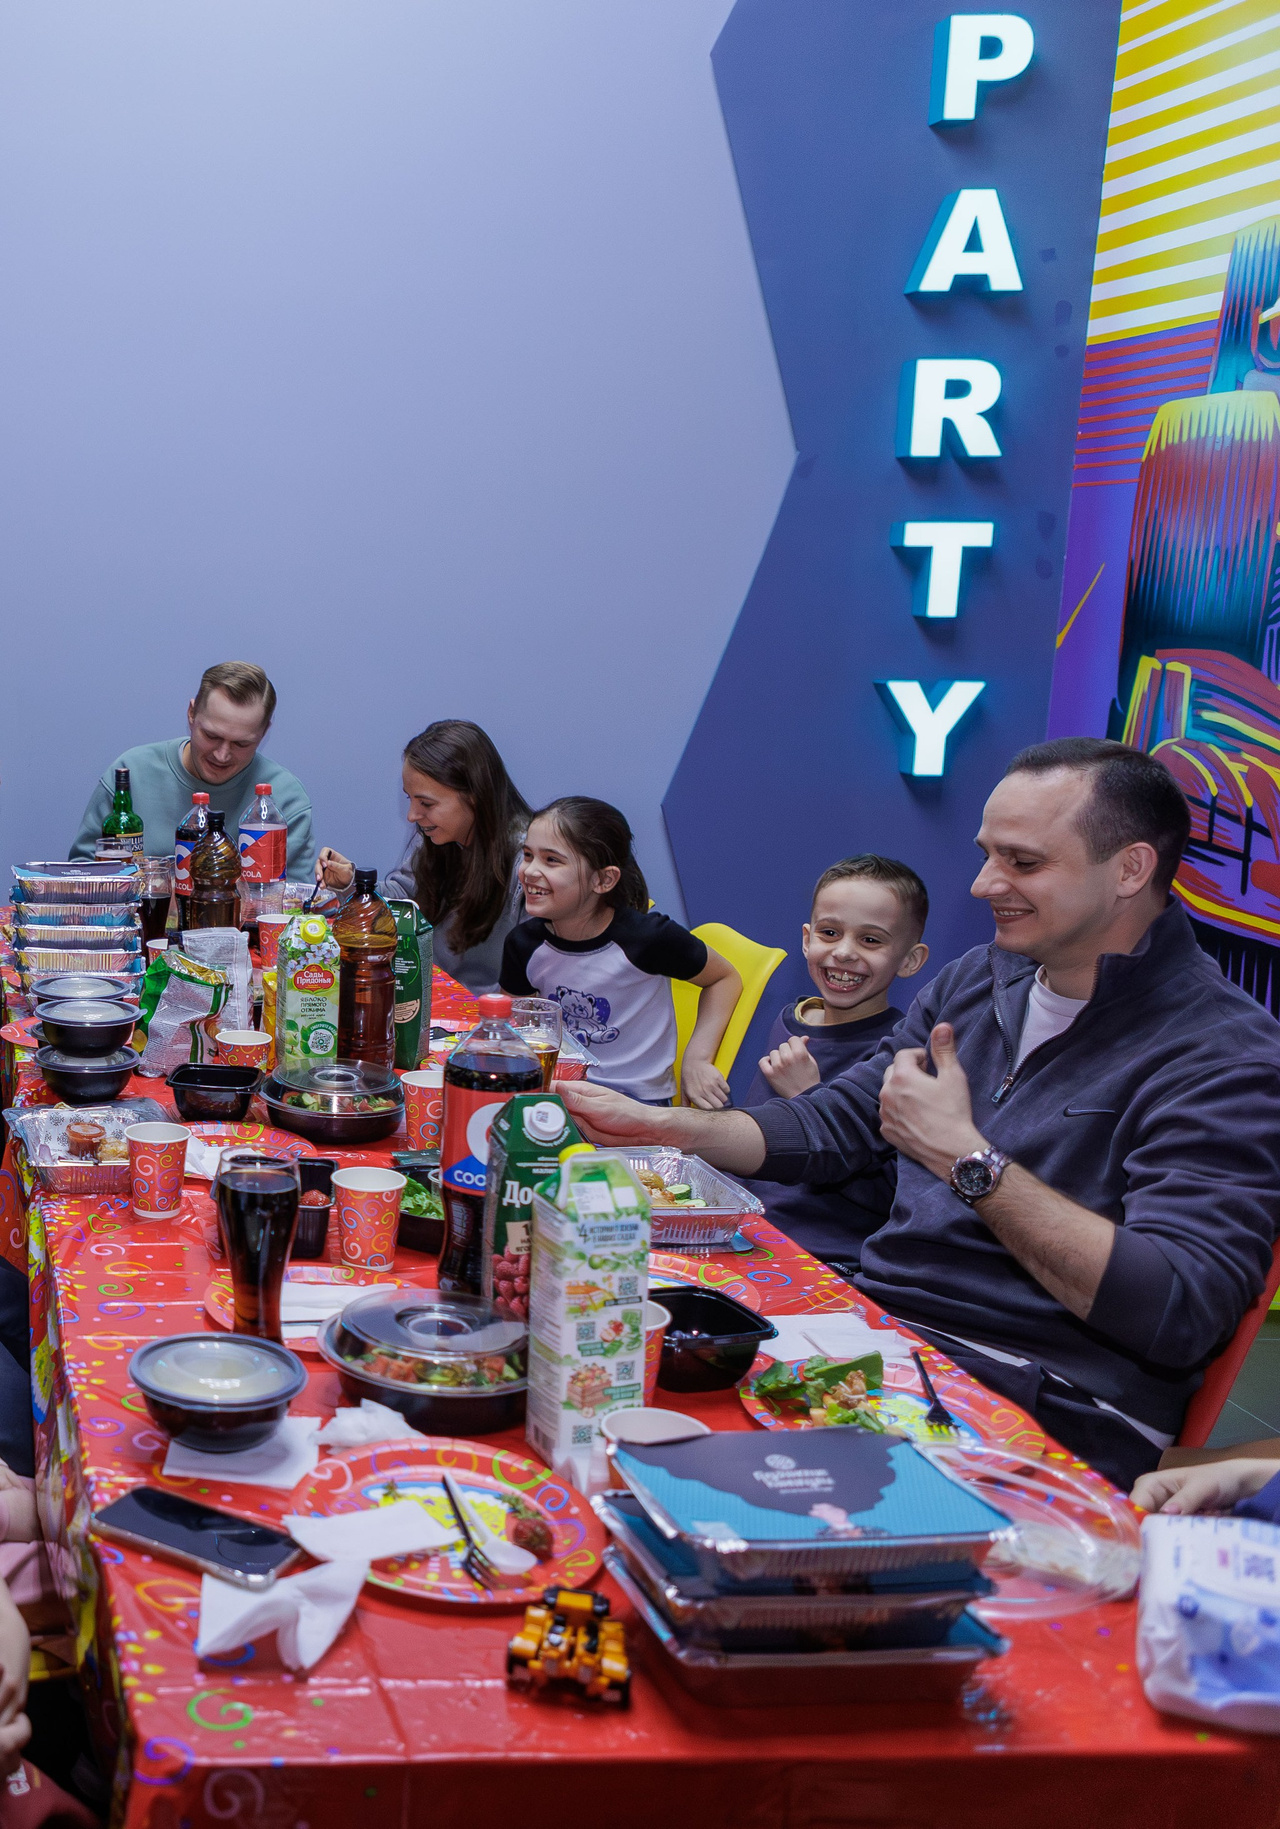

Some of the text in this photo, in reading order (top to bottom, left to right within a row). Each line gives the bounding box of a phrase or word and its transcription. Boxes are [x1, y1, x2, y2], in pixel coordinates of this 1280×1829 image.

[880, 13, 1035, 778] PARTY
[242, 870, 262, 879] COLA
[178, 882, 193, 891] COL
[297, 977, 331, 985] Придонья
[453, 1169, 487, 1187] COO
[503, 1180, 532, 1208] До
